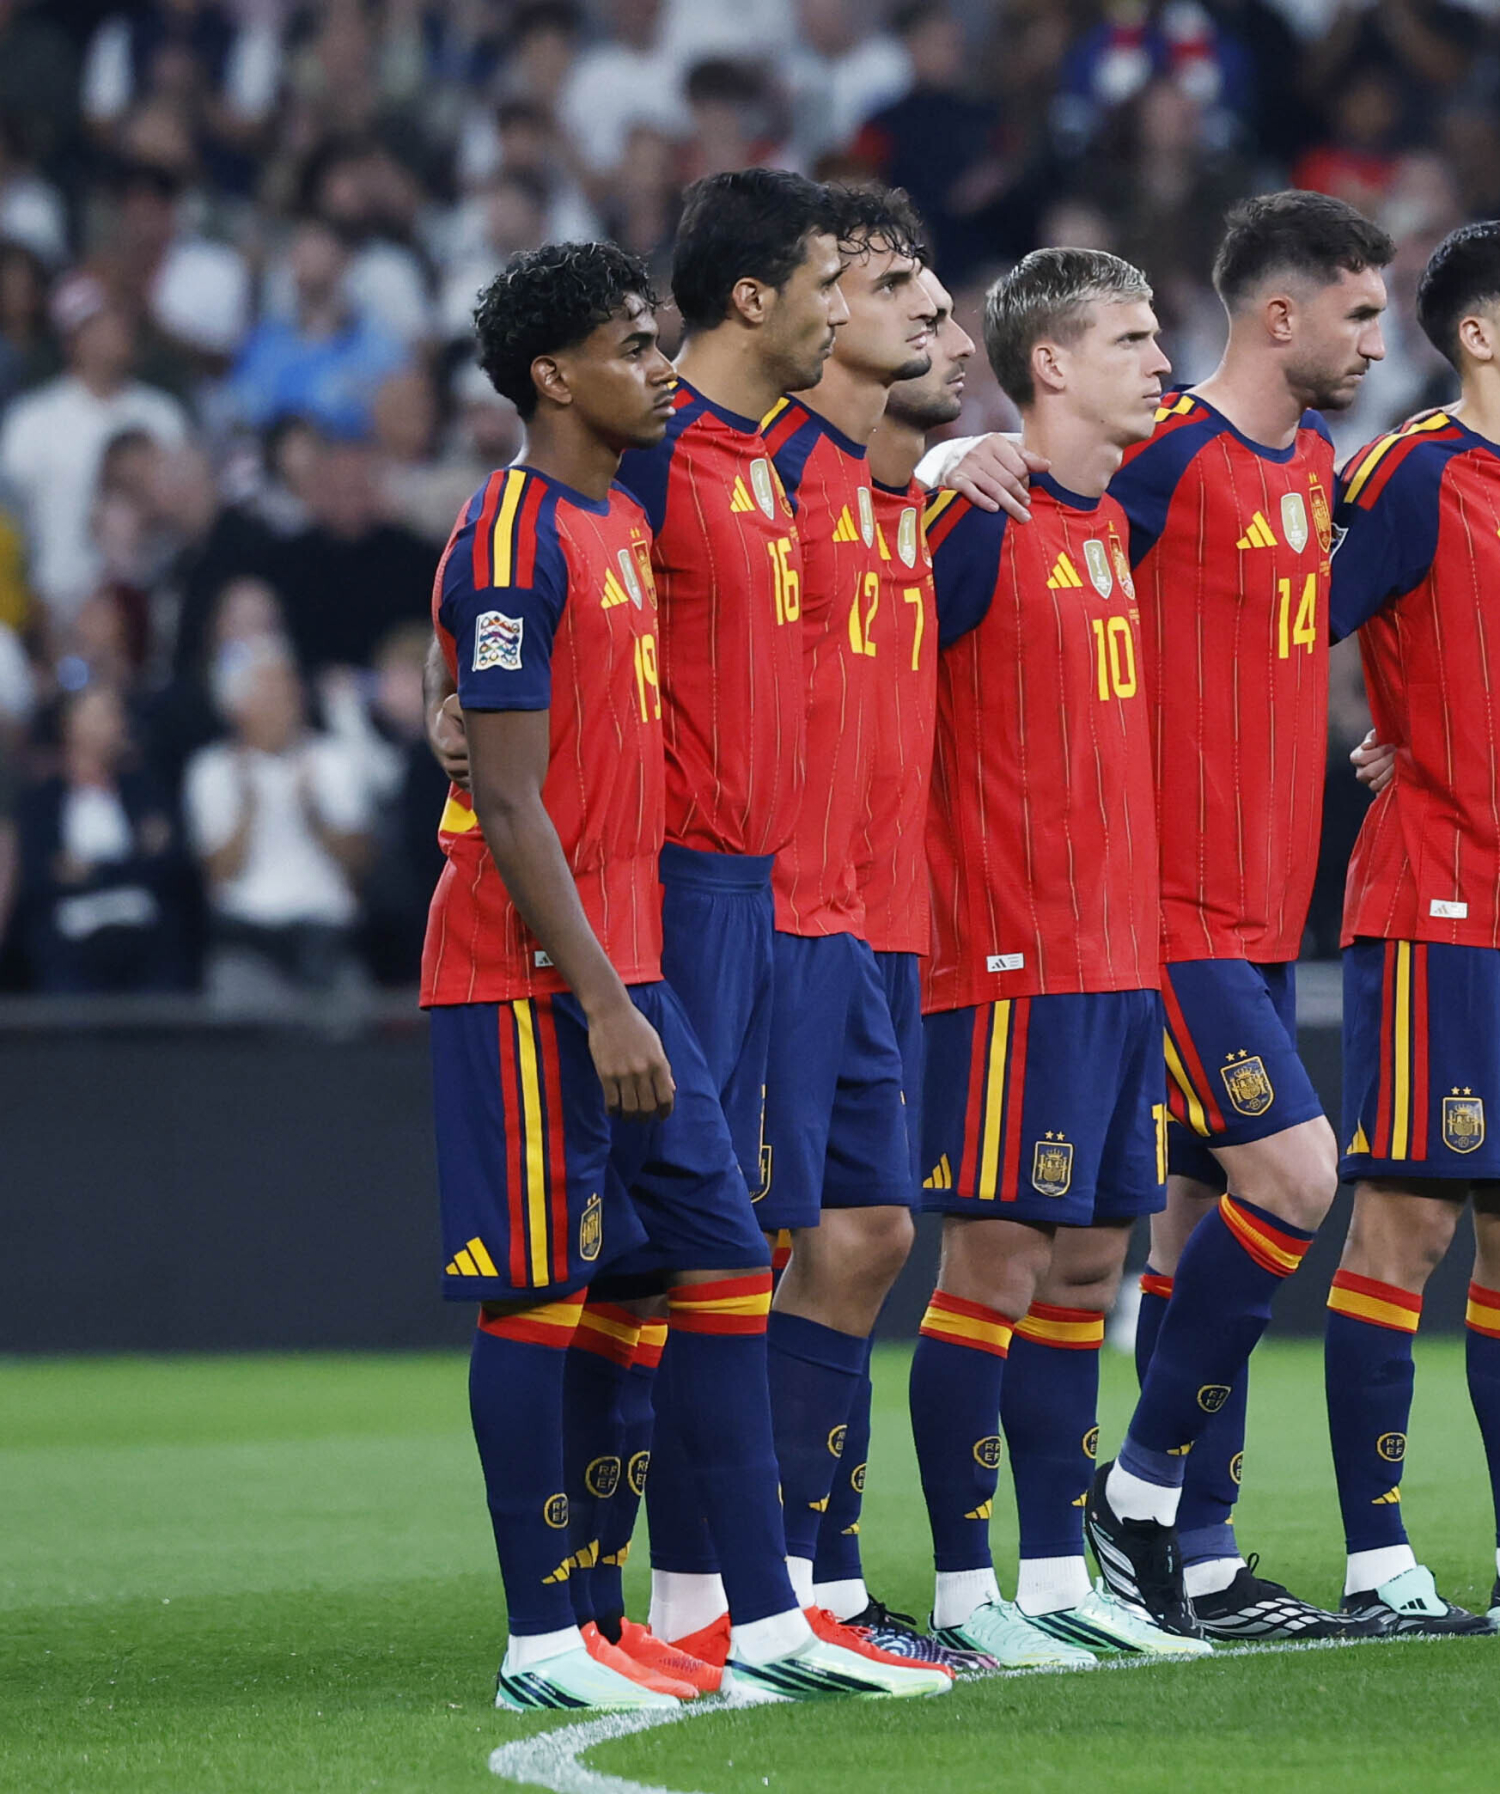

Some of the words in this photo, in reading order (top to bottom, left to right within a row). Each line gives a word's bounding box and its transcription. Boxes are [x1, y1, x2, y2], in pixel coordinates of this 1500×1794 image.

[767, 536, 800, 625] 16
[848, 571, 879, 657] 12
[1278, 572, 1316, 659] 14
[903, 588, 924, 671] 7
[1092, 616, 1137, 701] 10
[633, 633, 662, 723] 19
